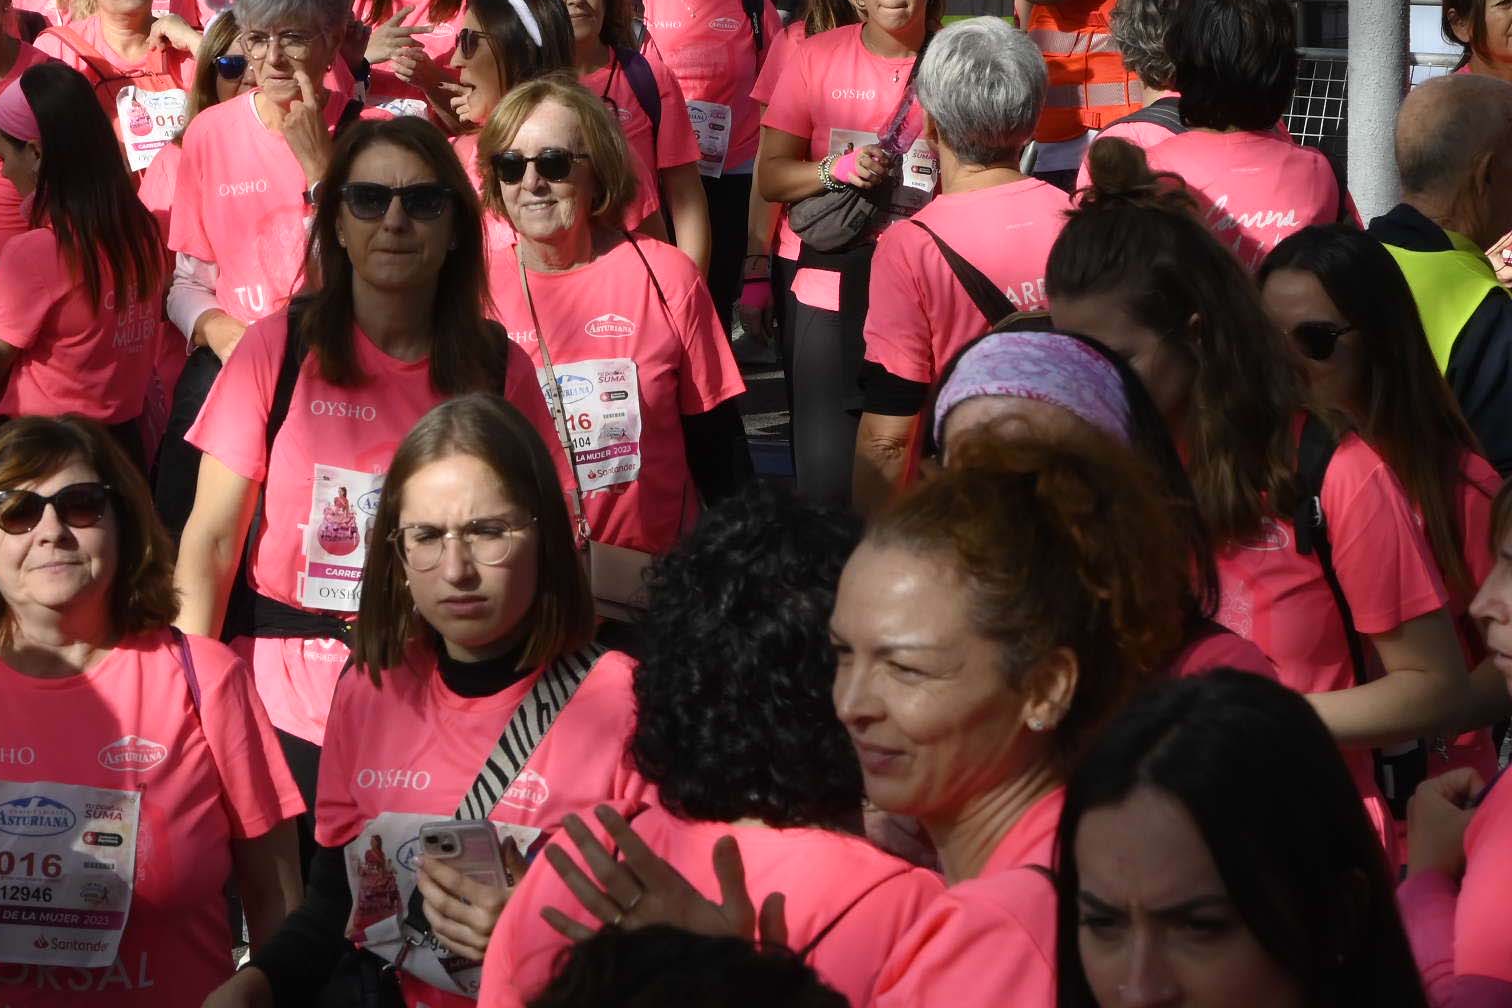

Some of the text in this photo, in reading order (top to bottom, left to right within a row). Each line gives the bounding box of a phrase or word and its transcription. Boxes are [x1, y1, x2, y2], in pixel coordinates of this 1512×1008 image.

[831, 89, 876, 100] OYSHO
[155, 114, 186, 127] 016
[219, 179, 268, 198] OYSHO
[234, 284, 265, 312] TU
[598, 375, 627, 384] SUMA
[310, 399, 377, 422] OYSHO
[586, 450, 611, 460] MUJER
[613, 446, 632, 455] 2023
[597, 462, 636, 478] Santander
[103, 745, 164, 766] ASTURIANA
[356, 768, 432, 791] OYSHO
[85, 809, 123, 821] SUMA
[0, 885, 53, 902] 12946
[2, 910, 19, 921] DE
[21, 911, 36, 922] LA
[39, 911, 80, 924] MUJER
[83, 915, 110, 926] 2023
[50, 937, 109, 953] Santander
